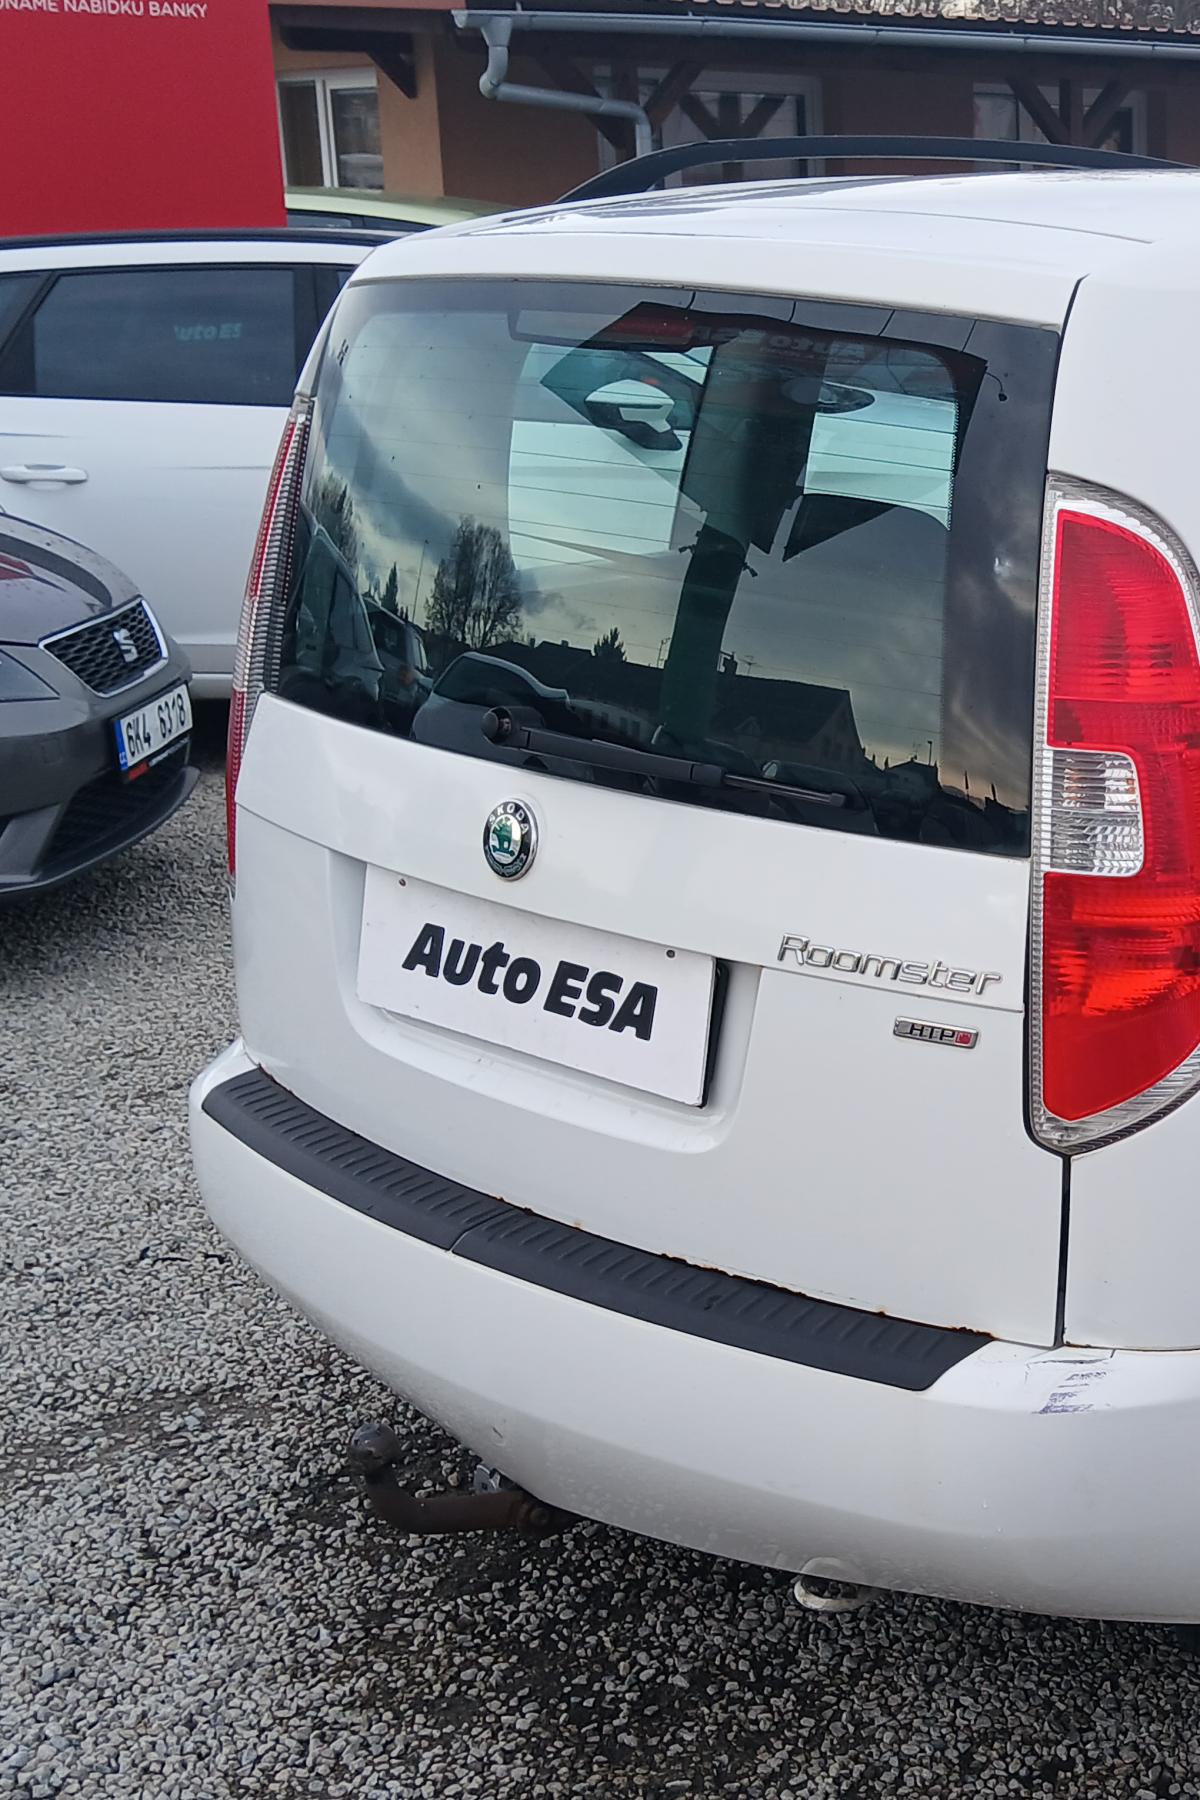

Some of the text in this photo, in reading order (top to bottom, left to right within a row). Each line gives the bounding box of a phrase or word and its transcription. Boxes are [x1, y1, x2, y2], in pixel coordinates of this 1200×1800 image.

[148, 0, 208, 19] BANKY
[401, 922, 658, 1041] Auto ESA
[777, 932, 1002, 996] Roomster
